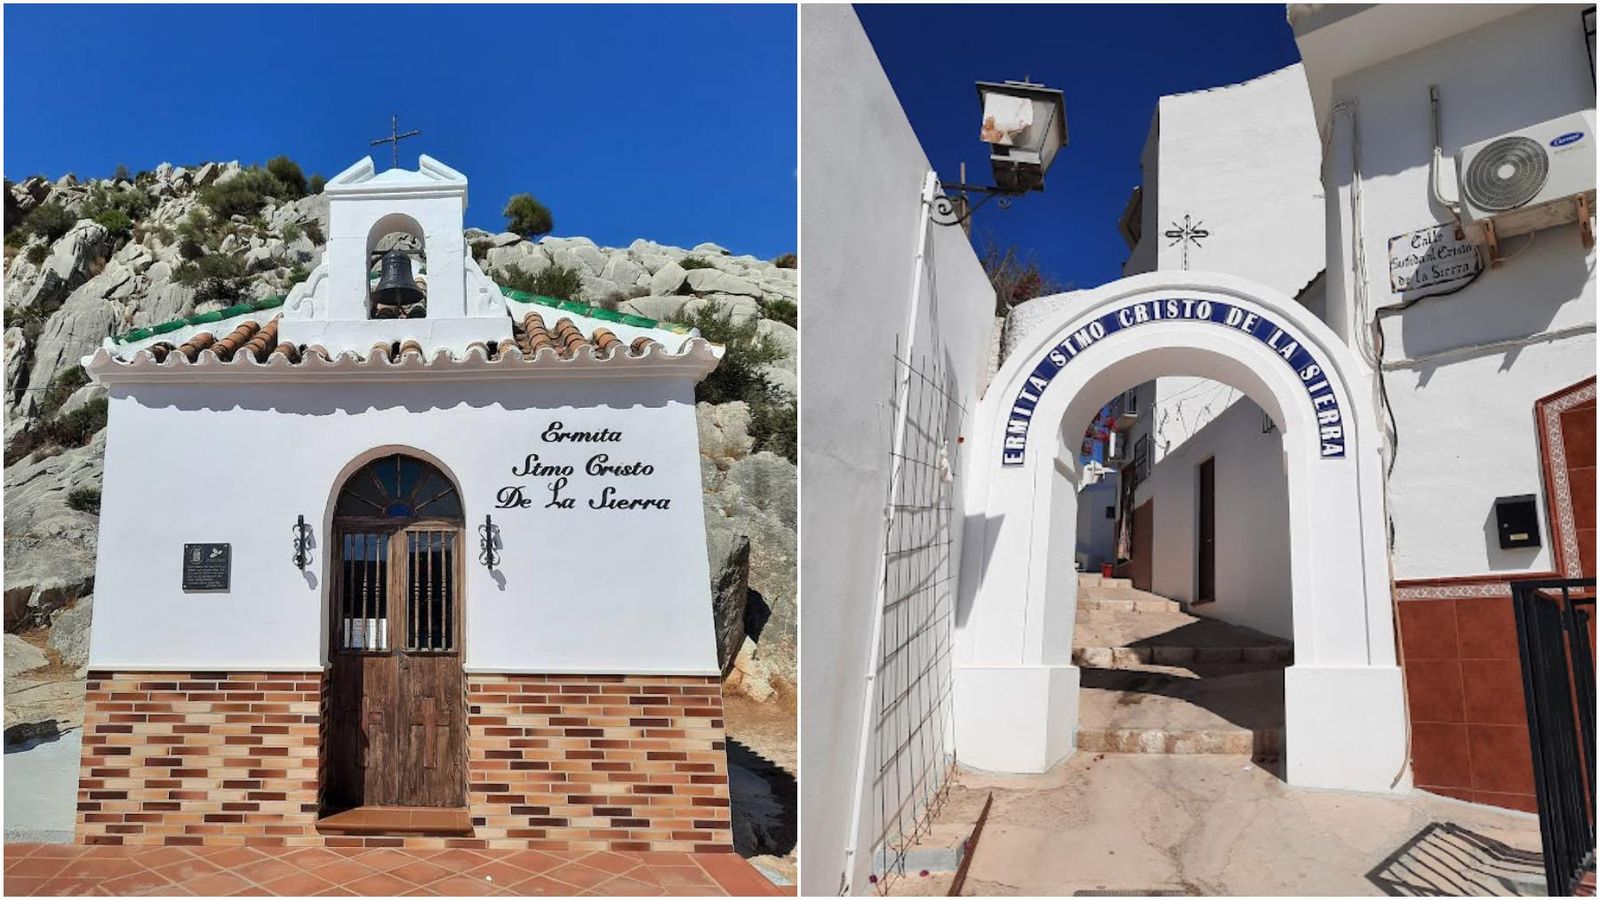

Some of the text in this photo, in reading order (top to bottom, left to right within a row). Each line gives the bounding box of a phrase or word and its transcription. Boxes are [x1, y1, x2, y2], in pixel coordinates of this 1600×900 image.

[1411, 230, 1443, 249] Calle
[1438, 244, 1472, 259] Cristo
[1416, 269, 1428, 283] la
[1432, 263, 1469, 278] Sierra
[1004, 299, 1344, 464] ERMITA STMO CRISTO DE LA SIERRA
[541, 421, 622, 442] Ermita
[512, 453, 654, 476] Stmo Cristo
[495, 477, 671, 509] De La Sierra
